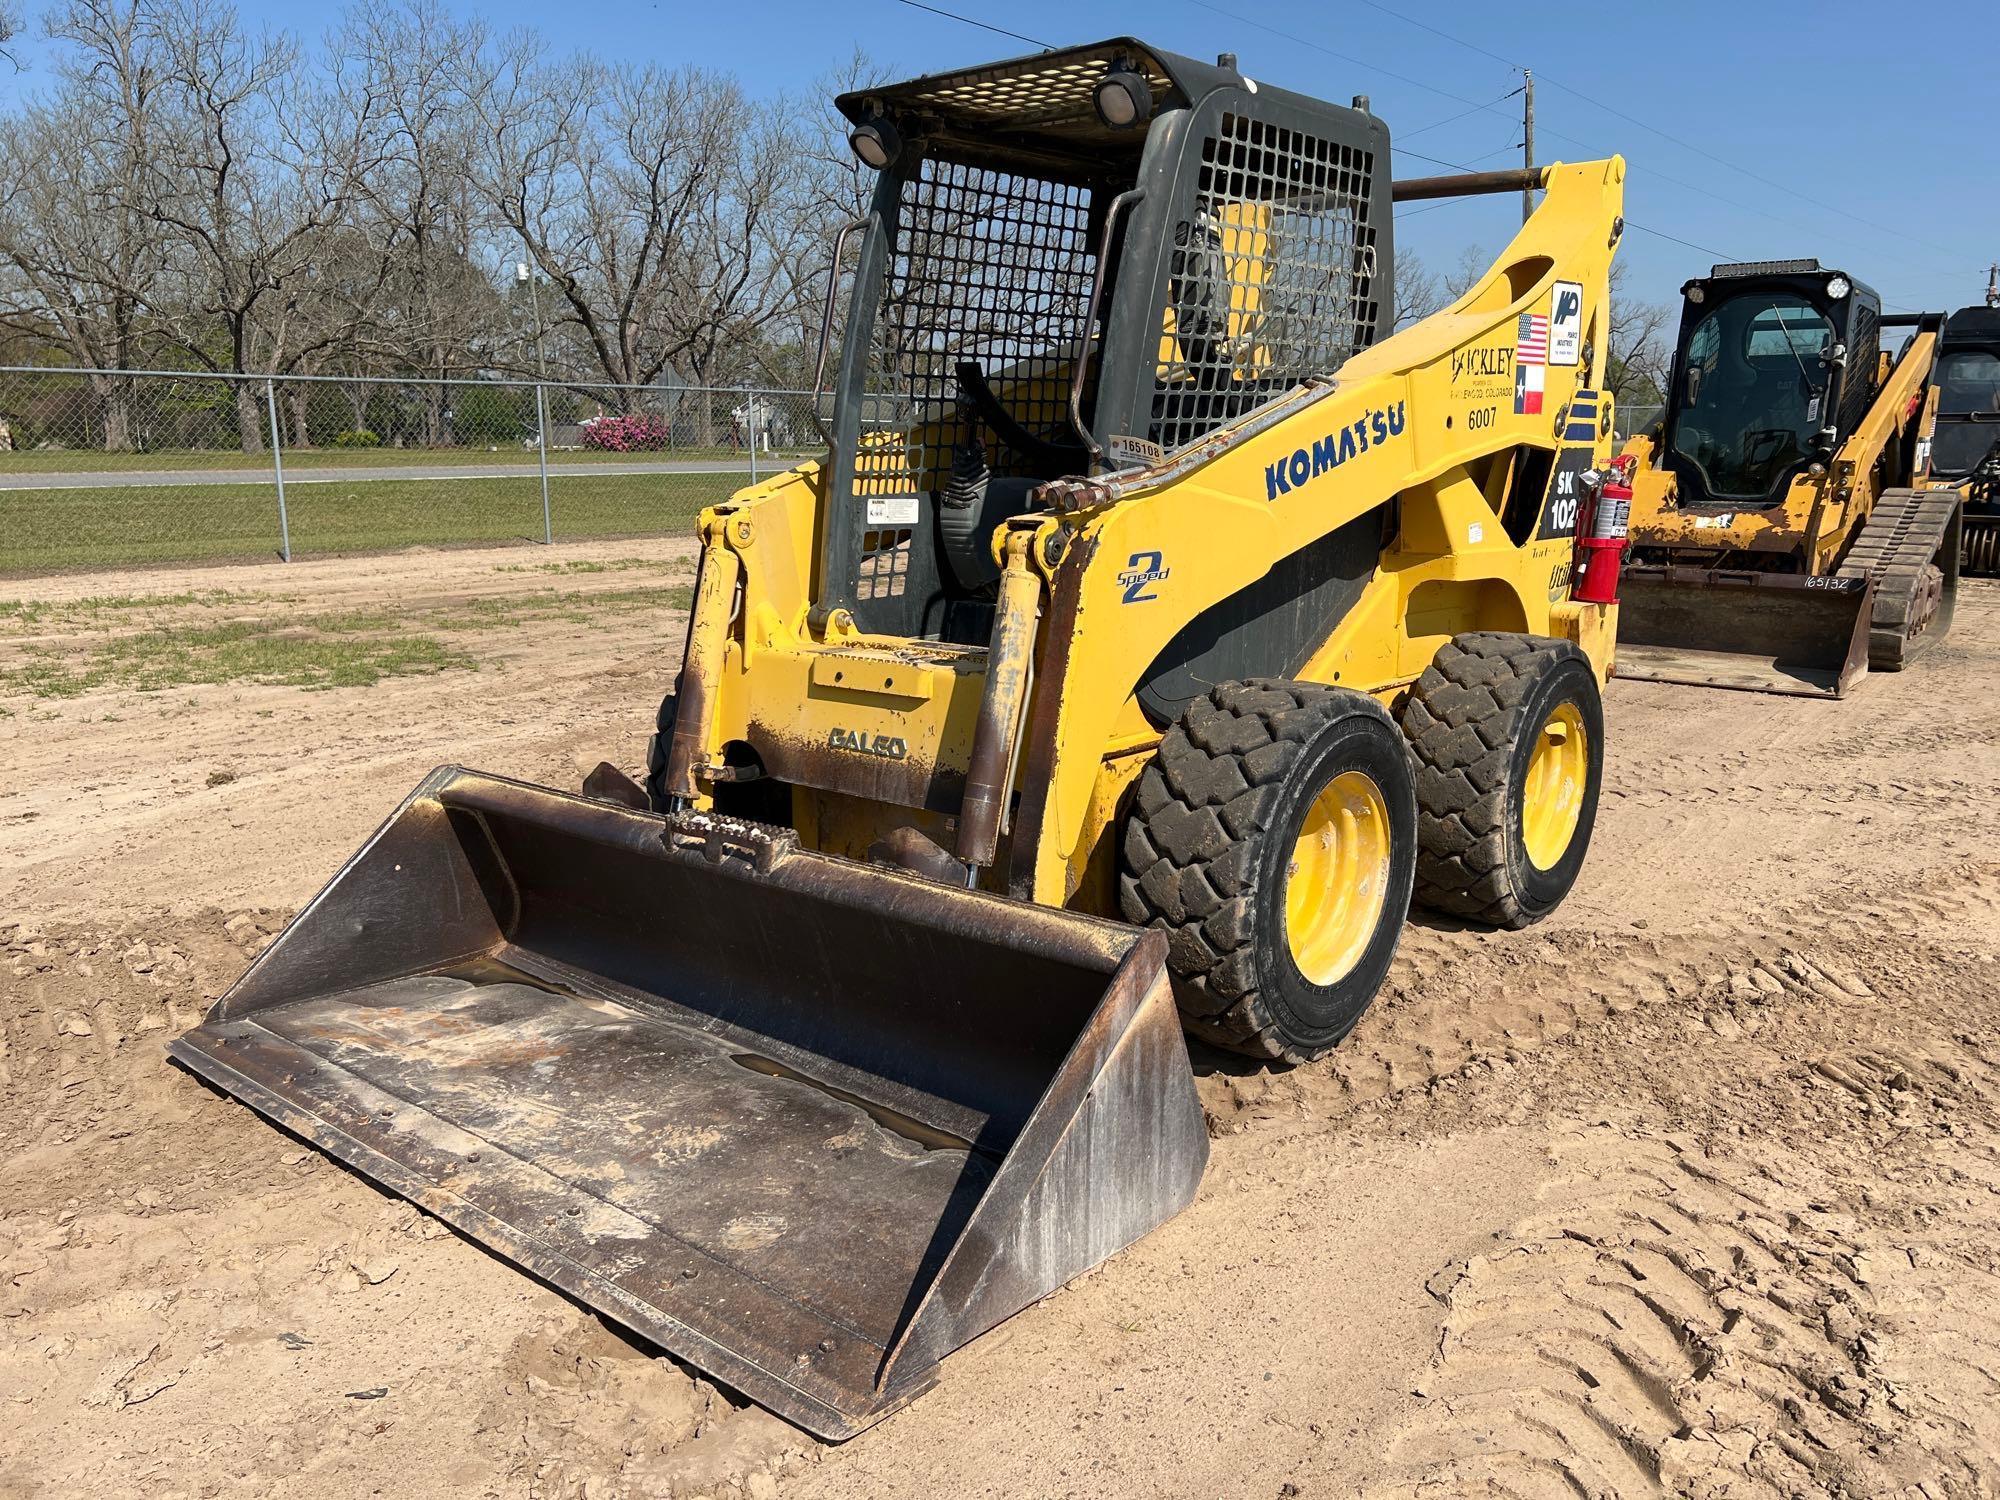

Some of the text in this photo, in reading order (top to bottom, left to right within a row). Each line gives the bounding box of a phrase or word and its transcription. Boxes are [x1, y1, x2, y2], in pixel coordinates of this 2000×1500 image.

[1485, 387, 1513, 398] COLORADO
[1468, 406, 1497, 430] 6007
[1122, 439, 1160, 458] 165108
[1265, 400, 1406, 502] KOMATSU
[1557, 470, 1574, 495] SK
[1551, 499, 1578, 530] 102
[1116, 551, 1170, 604] 2 Speed
[1804, 576, 1849, 590] 165132
[828, 727, 907, 760] GALEO
